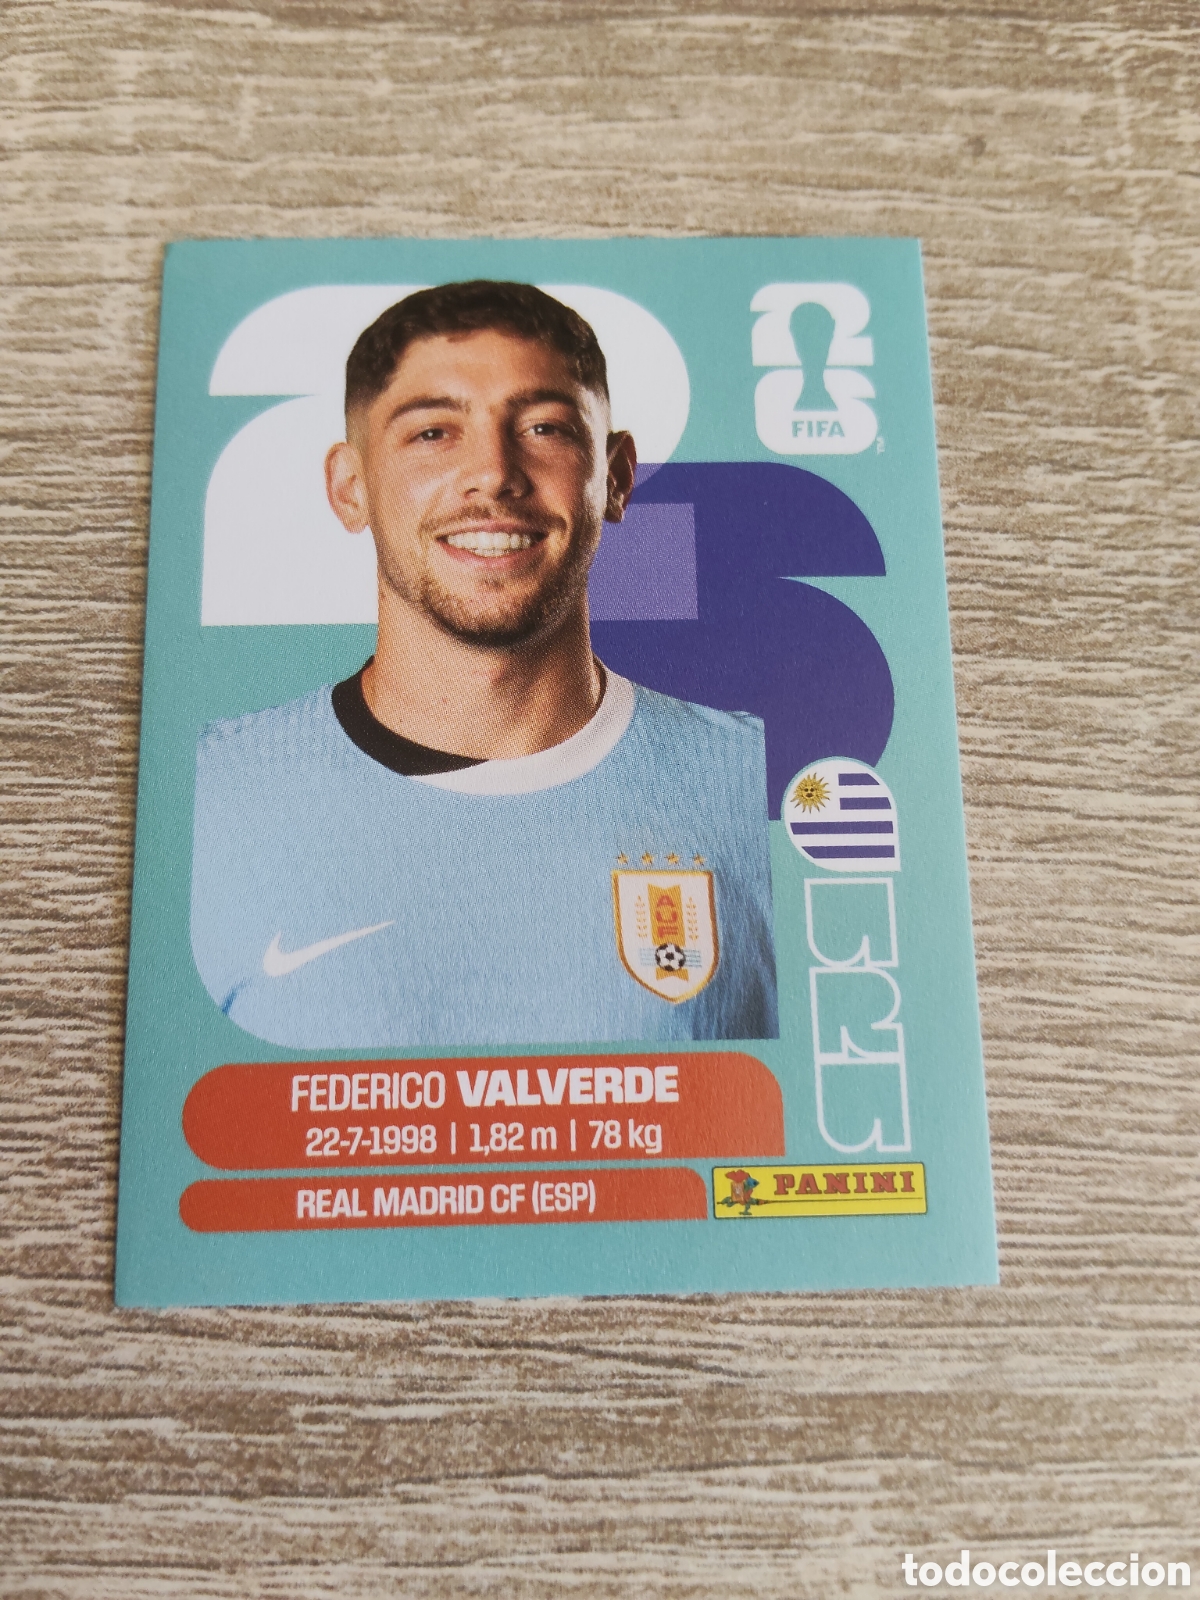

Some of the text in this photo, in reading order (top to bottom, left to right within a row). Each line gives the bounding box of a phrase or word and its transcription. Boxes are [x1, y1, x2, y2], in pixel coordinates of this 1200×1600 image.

[791, 420, 845, 438] FIFA
[291, 1066, 679, 1112] FEDERICO VALVERDE
[306, 1124, 437, 1157] 22-7-1998
[469, 1122, 524, 1156] 1,82
[531, 1126, 557, 1151] m
[589, 1120, 621, 1149] 78
[629, 1119, 662, 1154] kg
[297, 1179, 596, 1219] REAL MADRID CF (ESP)
[773, 1171, 915, 1195] PANINI
